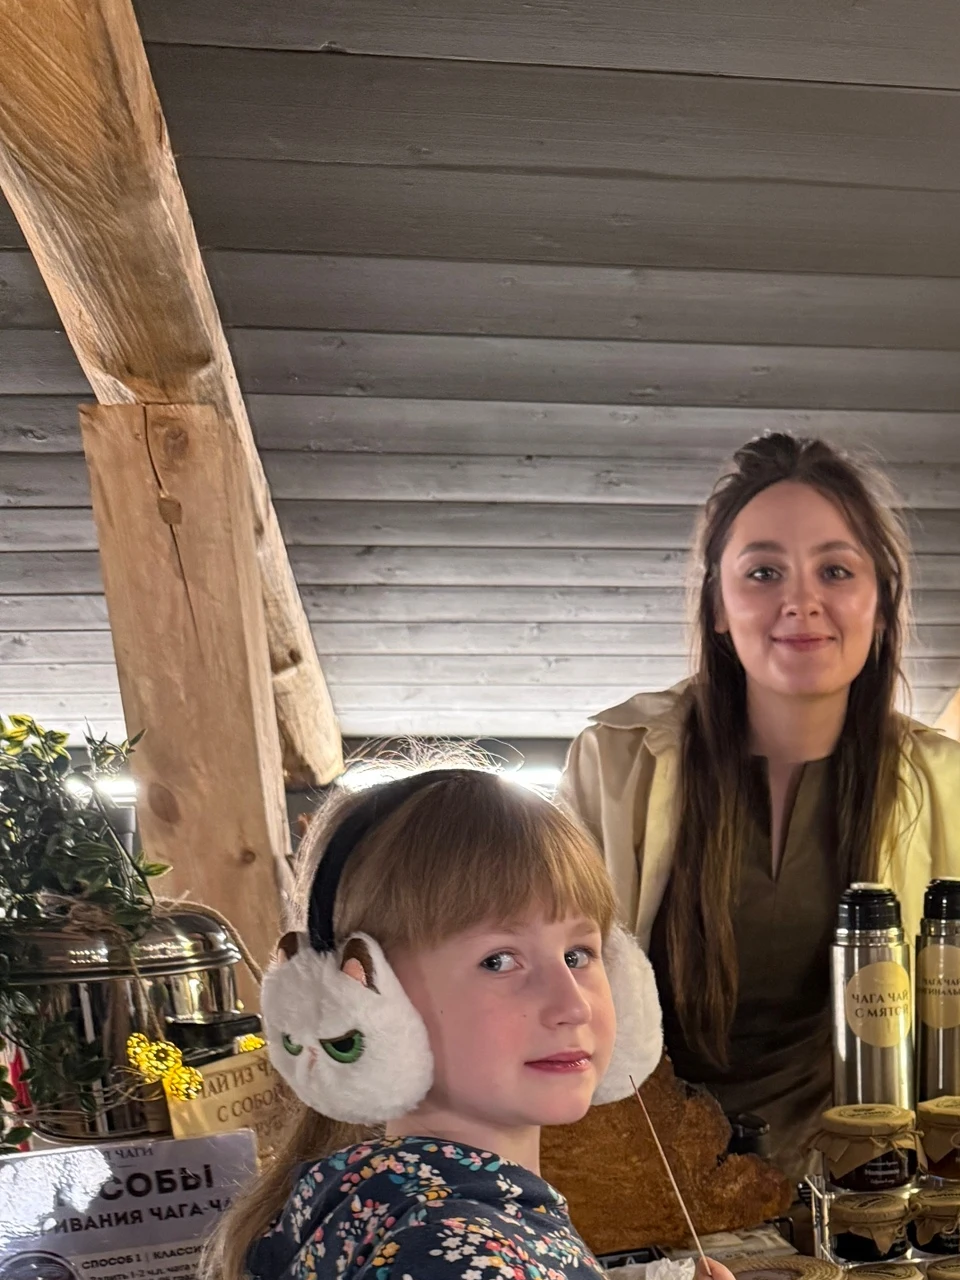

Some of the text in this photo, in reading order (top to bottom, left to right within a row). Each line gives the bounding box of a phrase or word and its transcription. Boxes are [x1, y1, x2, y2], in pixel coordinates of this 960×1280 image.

[851, 991, 909, 1004] ЧАГА ЧАЙ
[854, 1003, 909, 1018] С МЯТОЙ
[233, 1069, 255, 1088] ИЗ
[217, 1105, 229, 1123] С
[99, 1164, 214, 1200] СОБЫ
[52, 1212, 144, 1235] ИВАНИЯ
[82, 1254, 133, 1270] СПОСОБ
